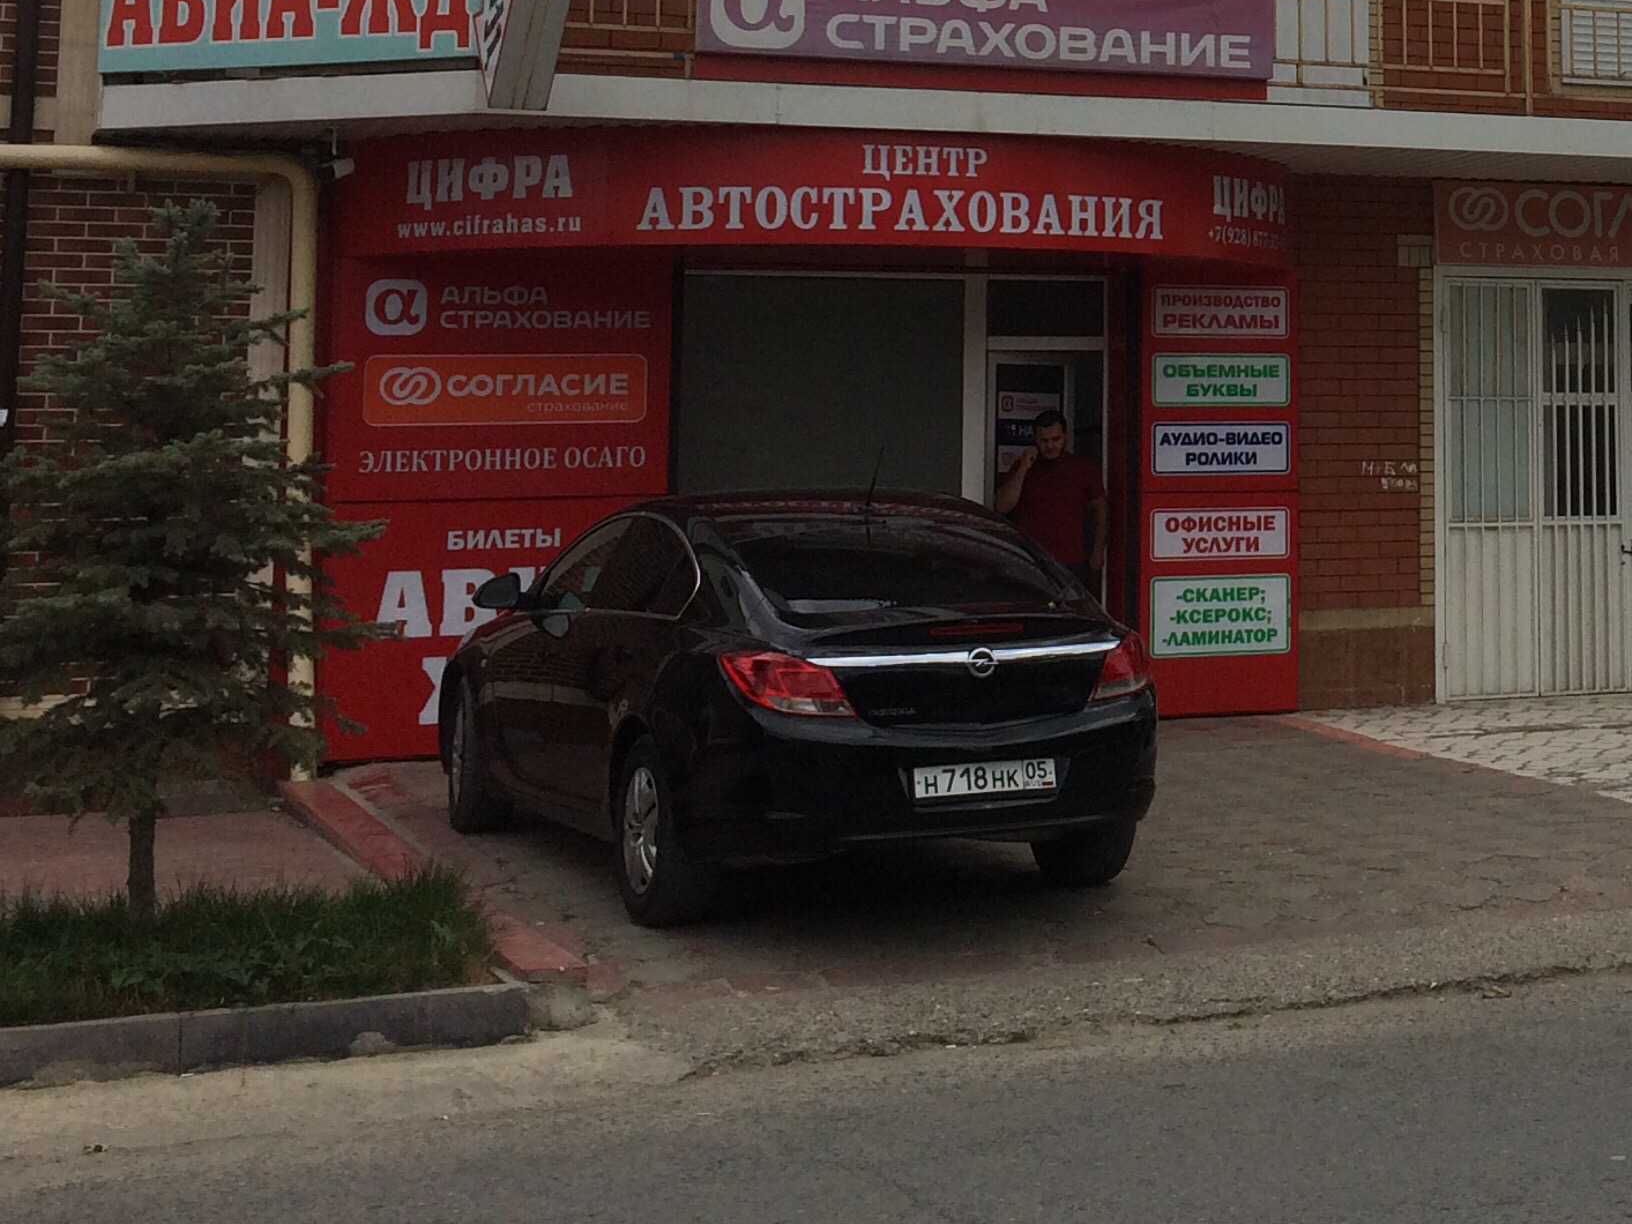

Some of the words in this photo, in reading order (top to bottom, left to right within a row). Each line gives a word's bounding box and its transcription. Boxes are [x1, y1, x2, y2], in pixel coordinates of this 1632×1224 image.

[826, 13, 1252, 70] СТРАХОВАНИЕ
[862, 144, 988, 181] ЦЕНТР
[406, 154, 573, 210] ЦИФРА
[1213, 175, 1285, 225] ЦИФРА
[636, 186, 1164, 240] АВТОСТРАХОВАНИЯ
[397, 213, 581, 238] www.cifrahas.ru
[1460, 241, 1619, 263] СТРАХОВАЯ
[440, 286, 548, 306] АЛЬФА
[1160, 294, 1281, 309] ПРОИЗВОДСТВО
[440, 310, 650, 329] СТРАХОВАНИЕ
[1162, 313, 1280, 329] РЕКЛАМЫ
[1162, 364, 1280, 378] ОБЪЕМНЫЕ
[447, 373, 629, 397] СОГЛАСИЕ
[1186, 384, 1258, 397] БУКВЫ
[527, 400, 628, 414] страхование
[1159, 432, 1283, 446] АУДИО-ВИДЕО
[358, 447, 557, 473] ЭЛЕКТРОННОЕ
[564, 445, 646, 469] ОСАГО
[1185, 452, 1258, 466] РОЛИКИ
[1164, 515, 1276, 533] ОФИСНЫЕ
[447, 528, 561, 551] БИЛЕТЫ
[1182, 536, 1260, 553] УСЛУГИ
[1176, 587, 1266, 604] -СКАНЕР;
[1169, 607, 1272, 625] -КСЕРОКС;
[1162, 628, 1278, 646] -ЛАМИНАТОР
[1025, 761, 1047, 779] 05
